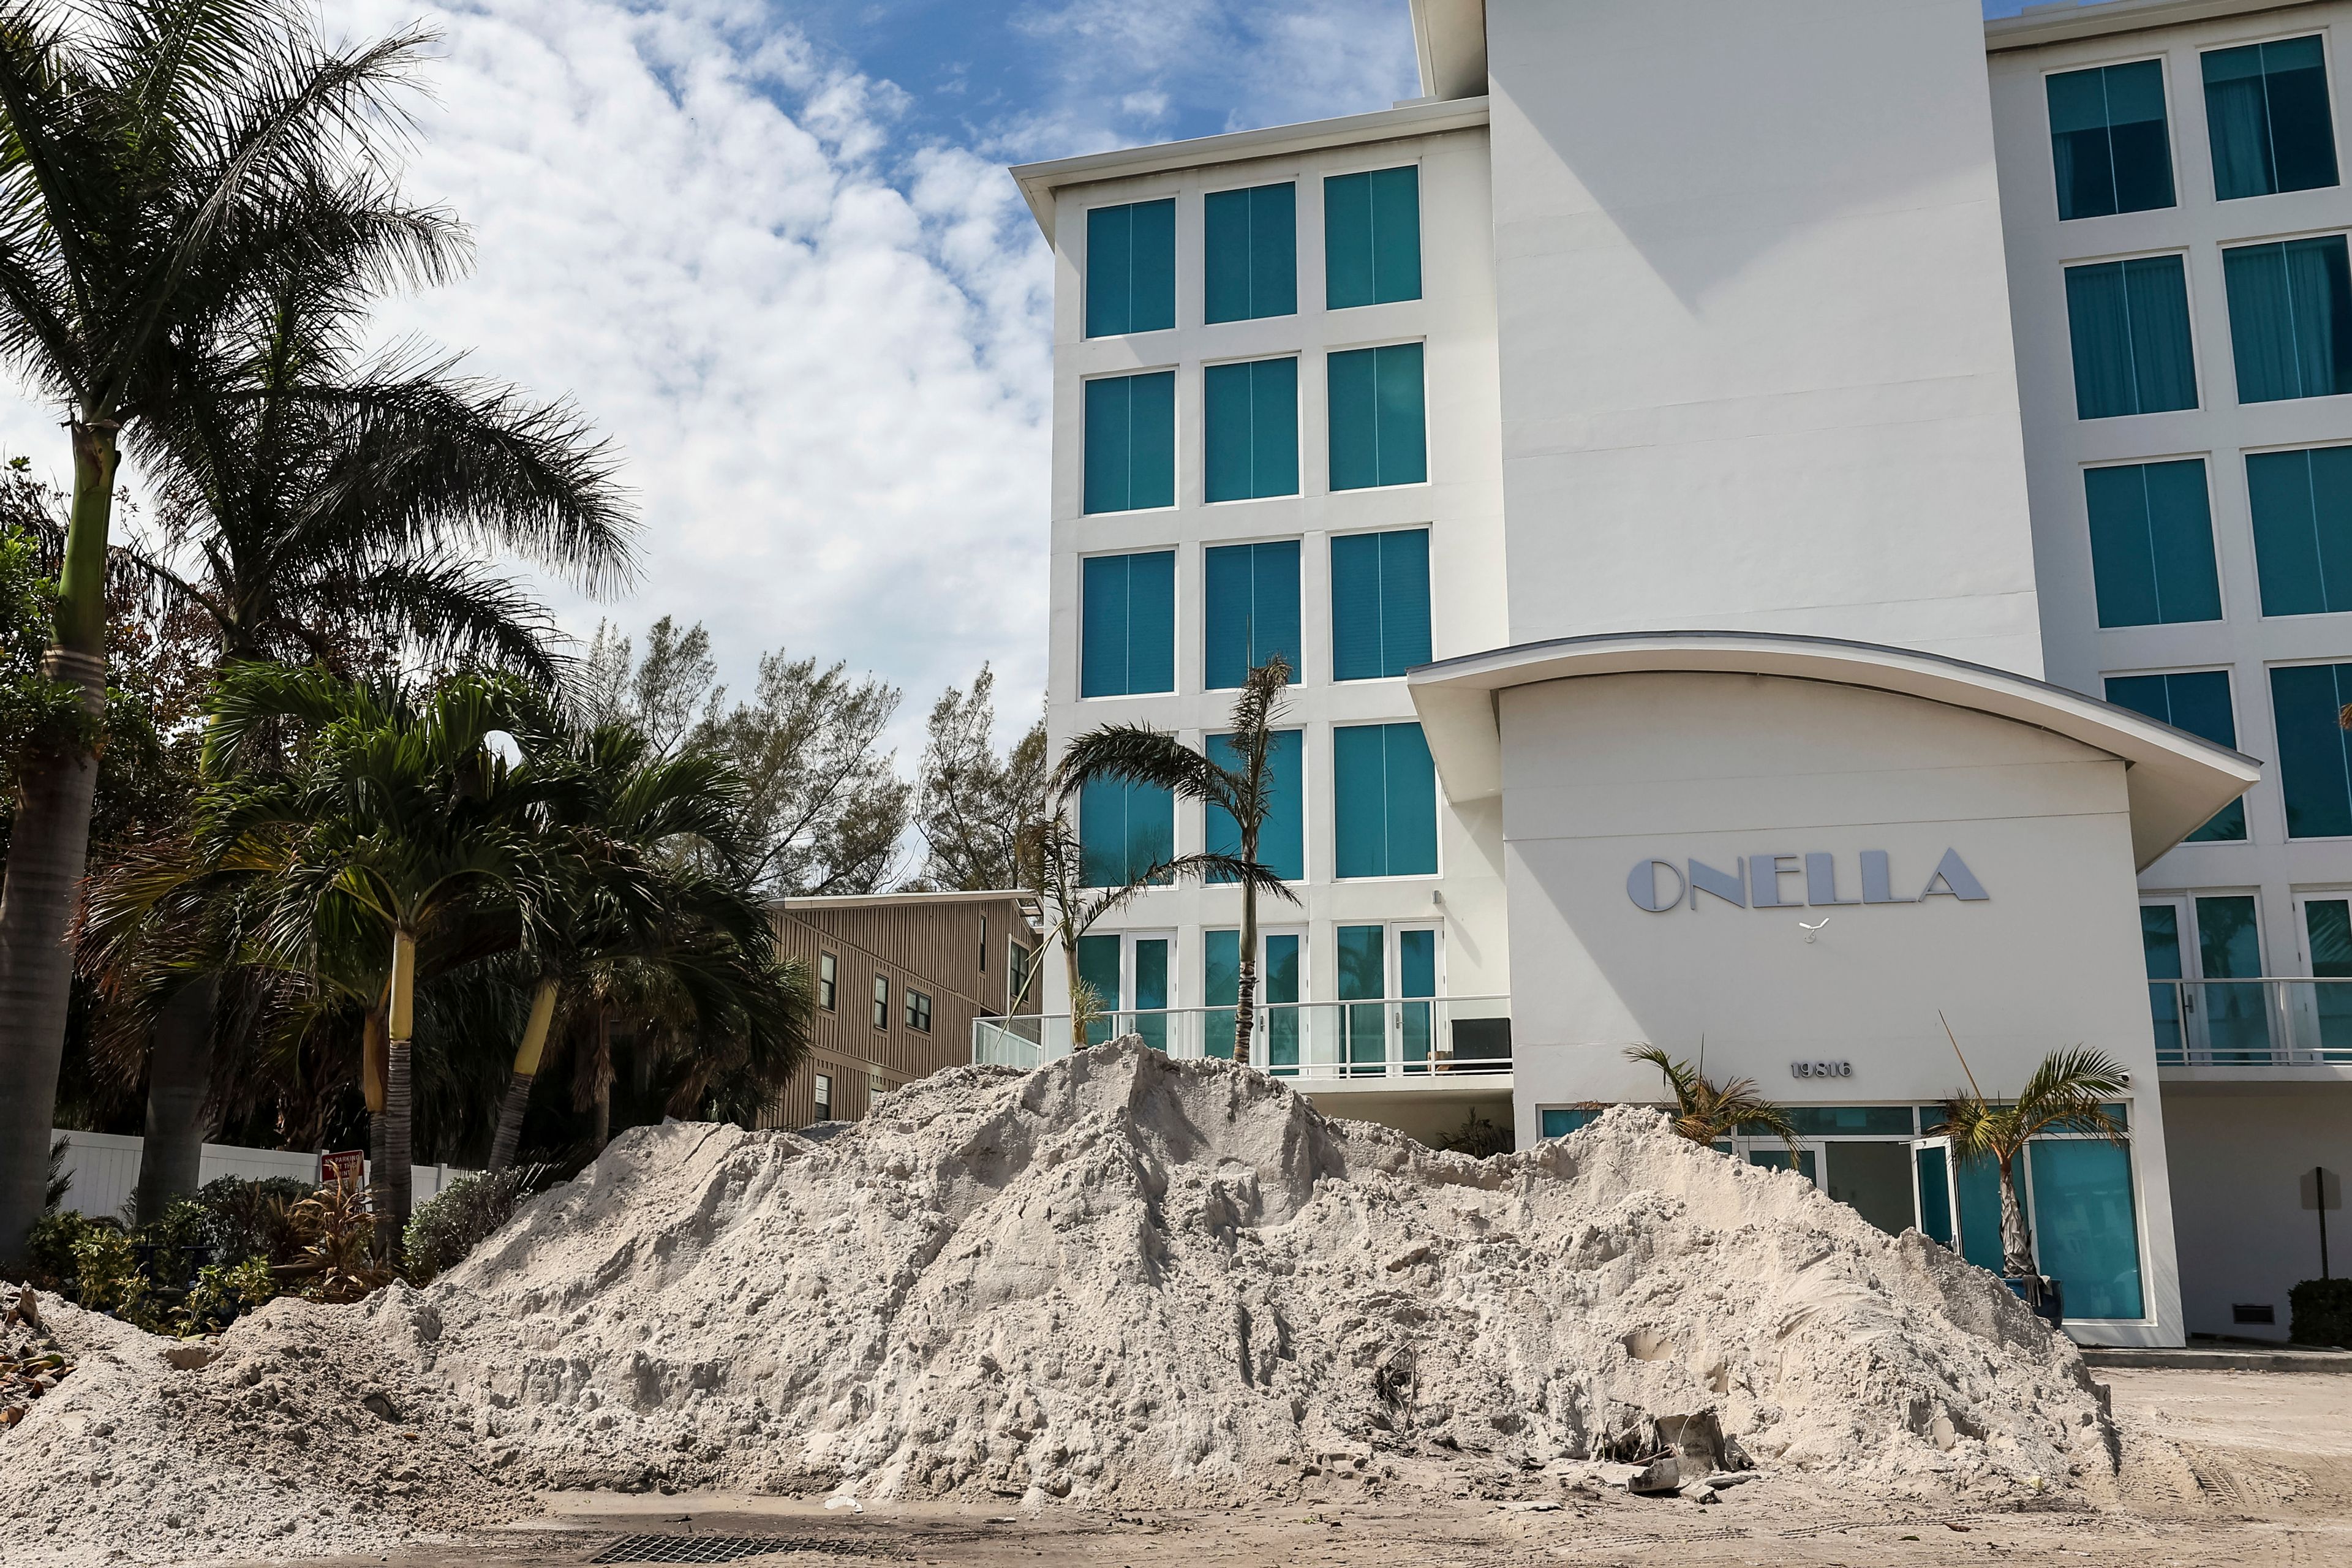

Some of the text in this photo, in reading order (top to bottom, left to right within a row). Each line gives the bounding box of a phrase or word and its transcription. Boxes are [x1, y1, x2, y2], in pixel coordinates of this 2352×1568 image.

[1627, 846, 1990, 912] ONELLA
[1790, 1061, 1852, 1078] 19816
[335, 1155, 360, 1163] PARKING
